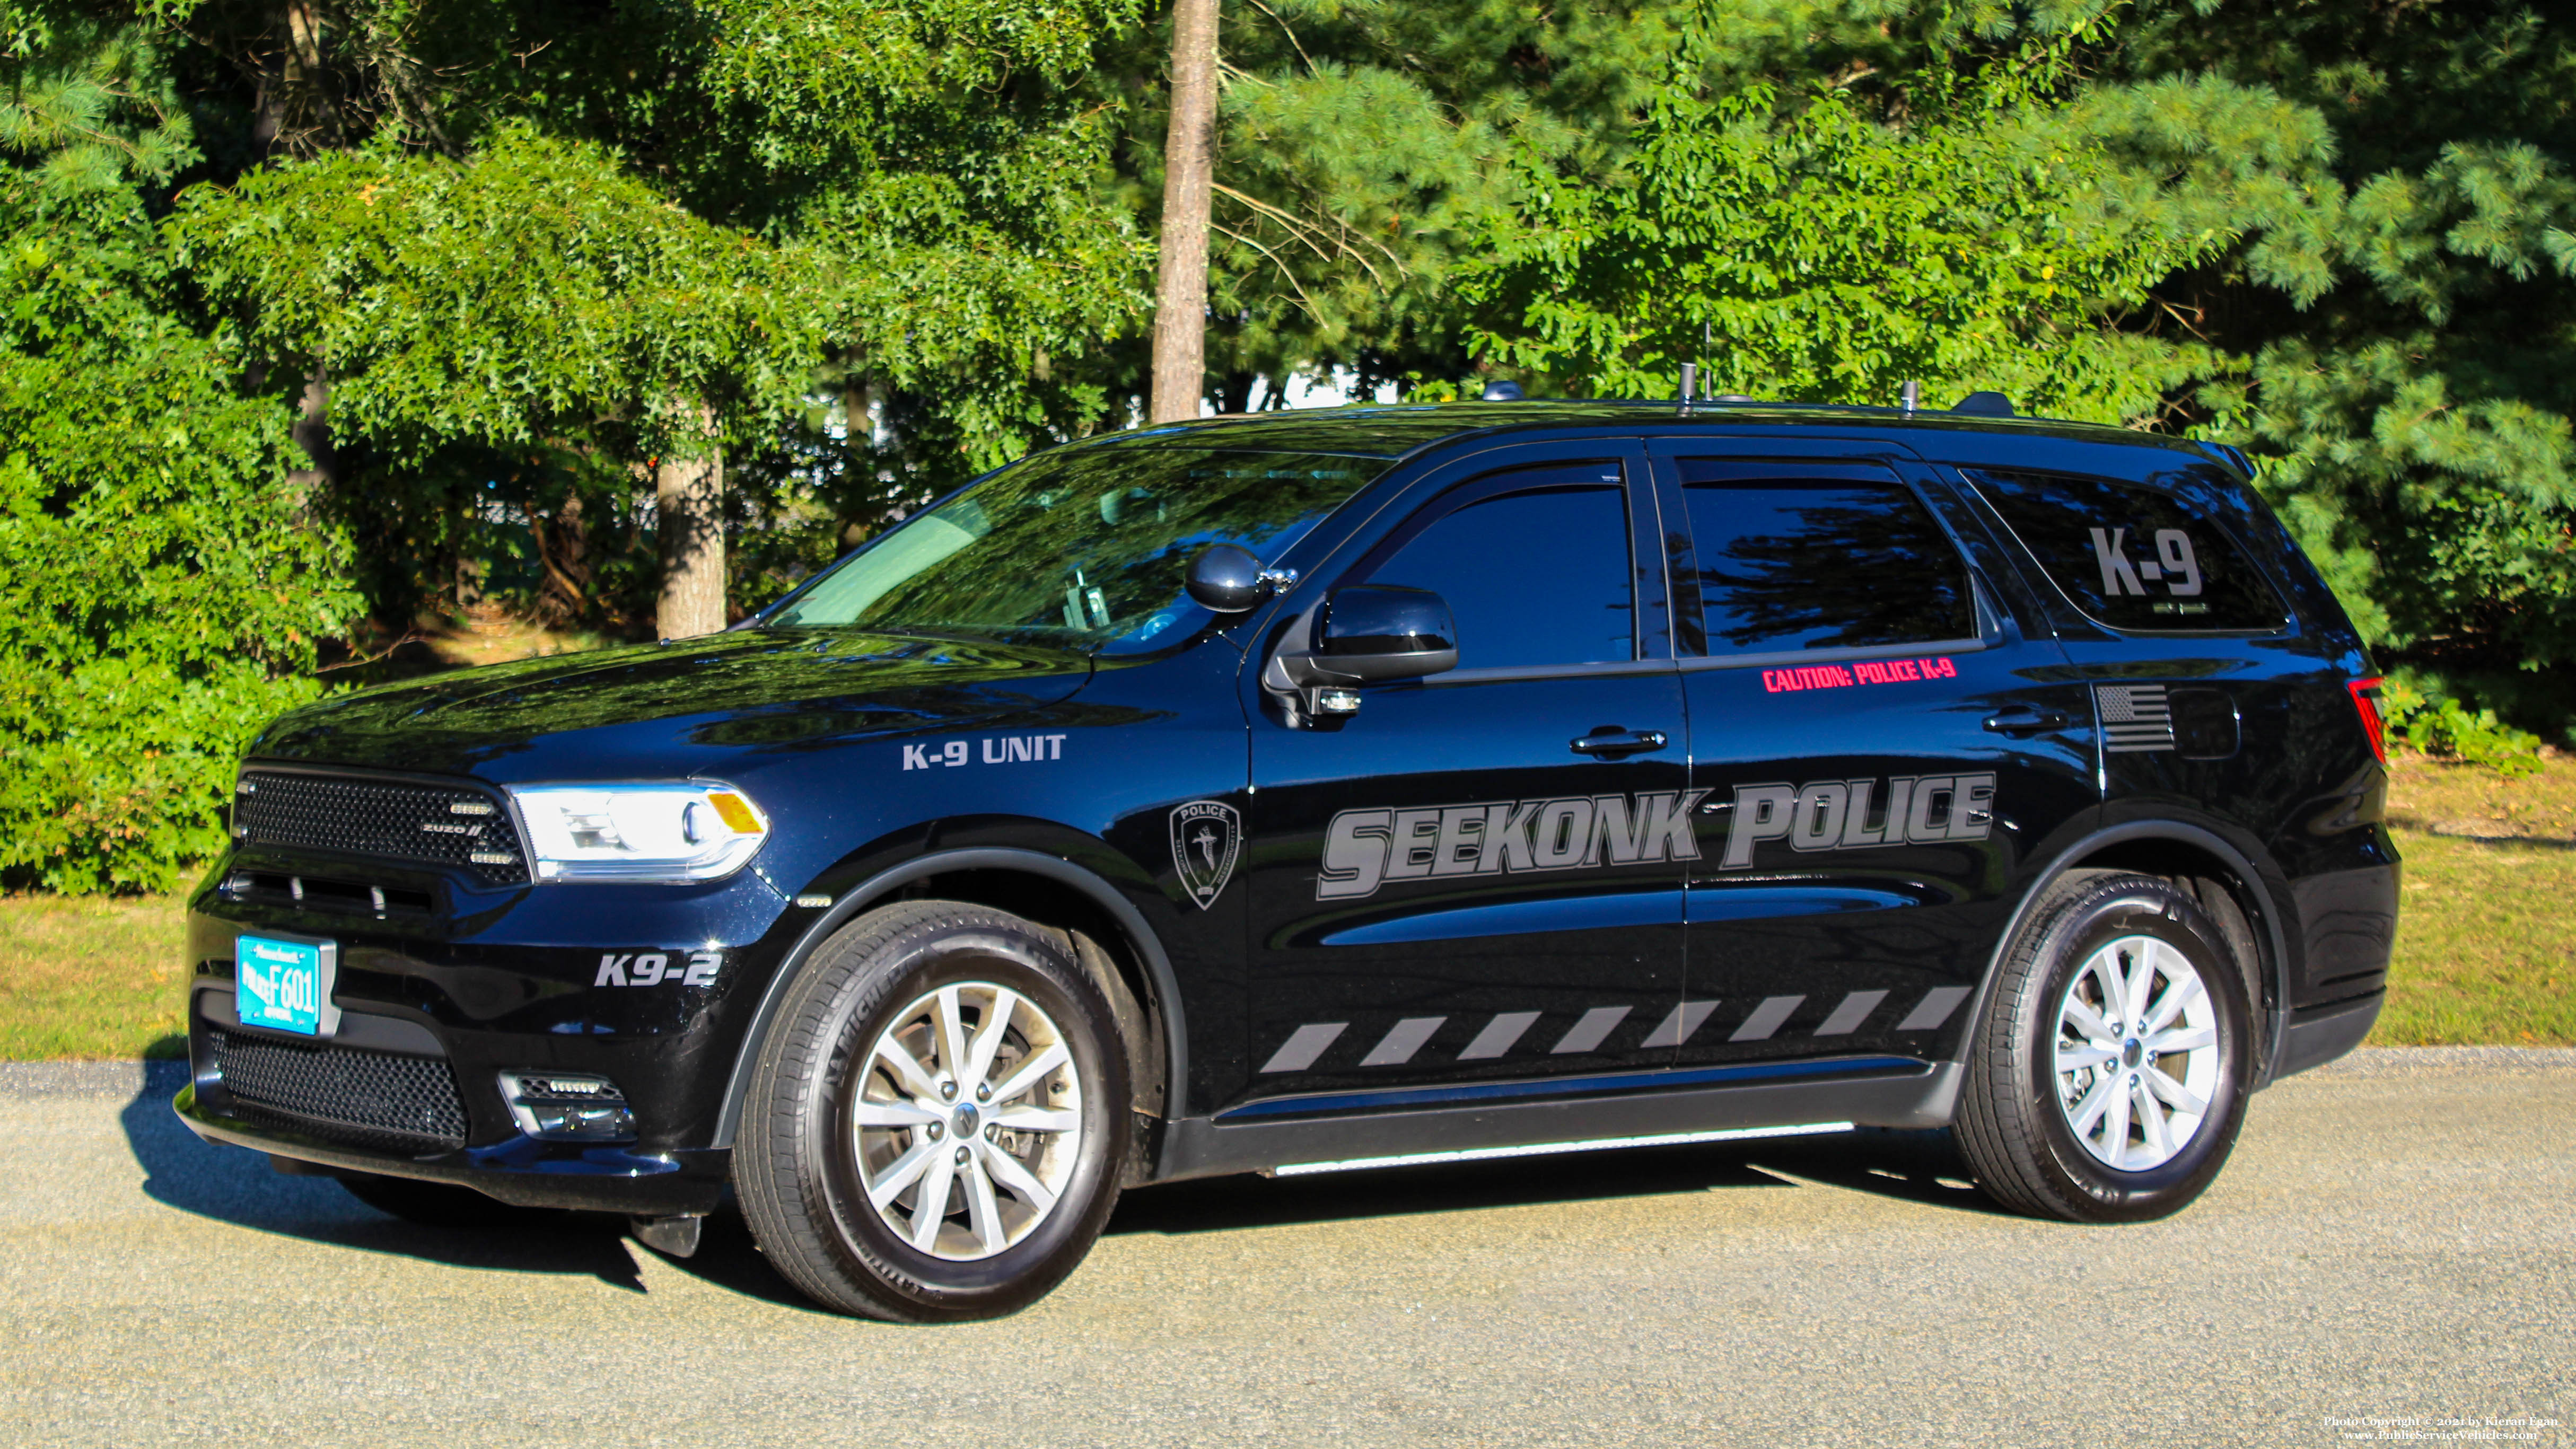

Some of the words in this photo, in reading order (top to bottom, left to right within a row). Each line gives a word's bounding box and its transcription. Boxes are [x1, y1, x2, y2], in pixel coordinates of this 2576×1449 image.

[2089, 528, 2202, 595] K-9
[1763, 665, 1854, 693] CAUTION:
[1853, 660, 1920, 684] POLICE
[1918, 657, 1957, 679] K-9
[903, 741, 968, 770] K-9
[982, 735, 1066, 764] UNIT
[1180, 805, 1227, 820] POLICE
[1316, 788, 1714, 900] SEEKONK
[1718, 771, 1997, 871] POLICE
[594, 954, 723, 987] K9-2
